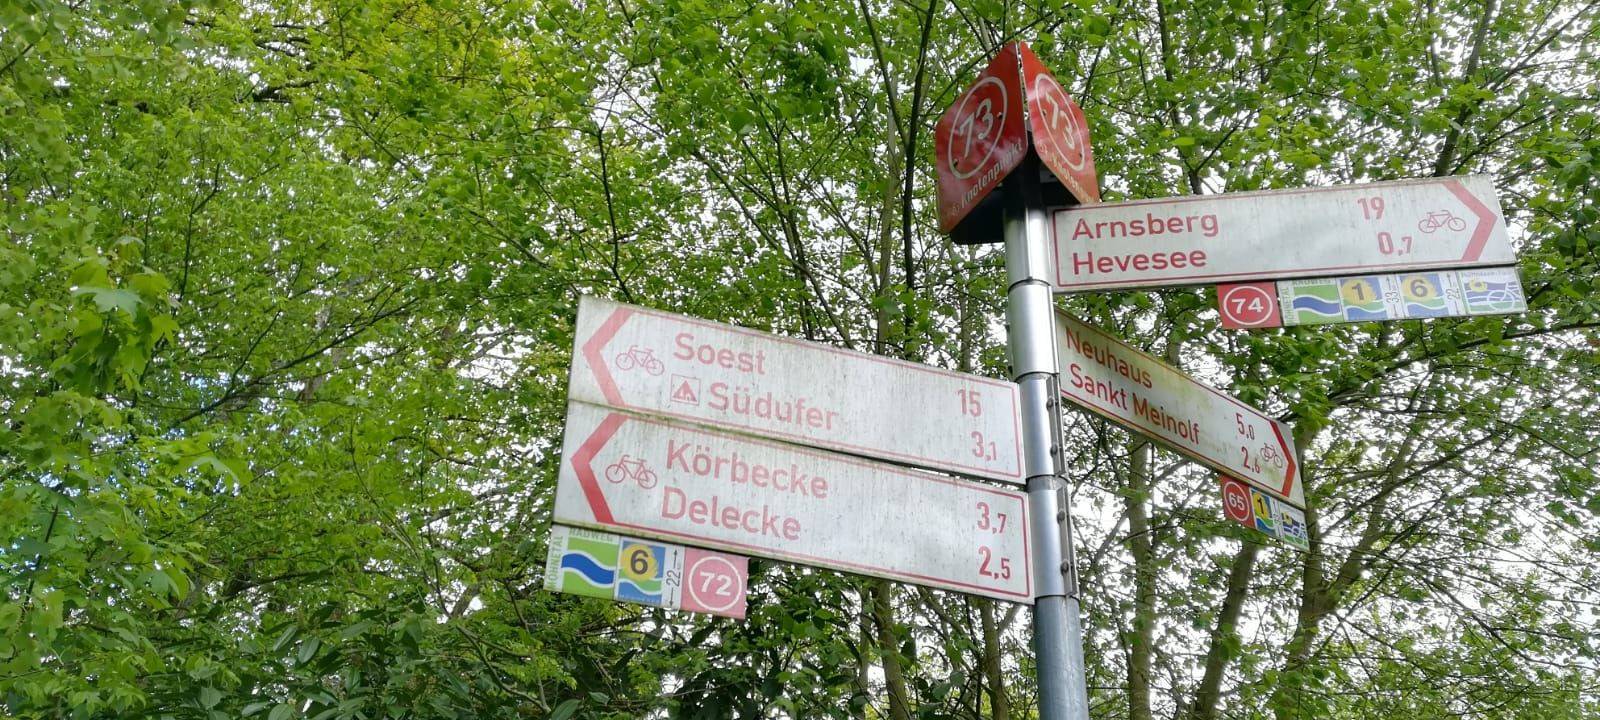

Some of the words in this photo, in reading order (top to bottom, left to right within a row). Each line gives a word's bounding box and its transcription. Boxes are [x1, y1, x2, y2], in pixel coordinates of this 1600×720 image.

[958, 98, 995, 159] 73
[1045, 92, 1076, 150] 73
[961, 137, 1023, 209] Knotenpunkt
[1072, 213, 1219, 240] Arnsberg
[1357, 197, 1385, 220] 19
[1072, 250, 1207, 275] Hevesee
[1377, 232, 1413, 256] 0,7
[1231, 297, 1264, 315] 74
[1351, 283, 1365, 301] 1
[1410, 279, 1428, 298] 6
[673, 332, 766, 375] Soest
[957, 388, 982, 417] 15
[1065, 326, 1153, 389] Neuhaus
[1235, 412, 1255, 441] 5,0
[708, 382, 839, 430] Südufer
[971, 430, 997, 461] 3,1
[1070, 363, 1128, 411] Sankt
[1132, 392, 1200, 445] Meinolf
[1241, 446, 1261, 474] 2,6
[666, 439, 829, 499] Körbecke
[976, 501, 1007, 534] 3,7
[1228, 492, 1245, 511] 65
[1256, 497, 1265, 516] 1
[568, 528, 614, 543] RADWEG
[661, 485, 801, 541] Delecke
[978, 545, 1011, 580] 2,5
[629, 550, 649, 575] 6
[665, 569, 681, 587] 22
[699, 571, 733, 597] 72
